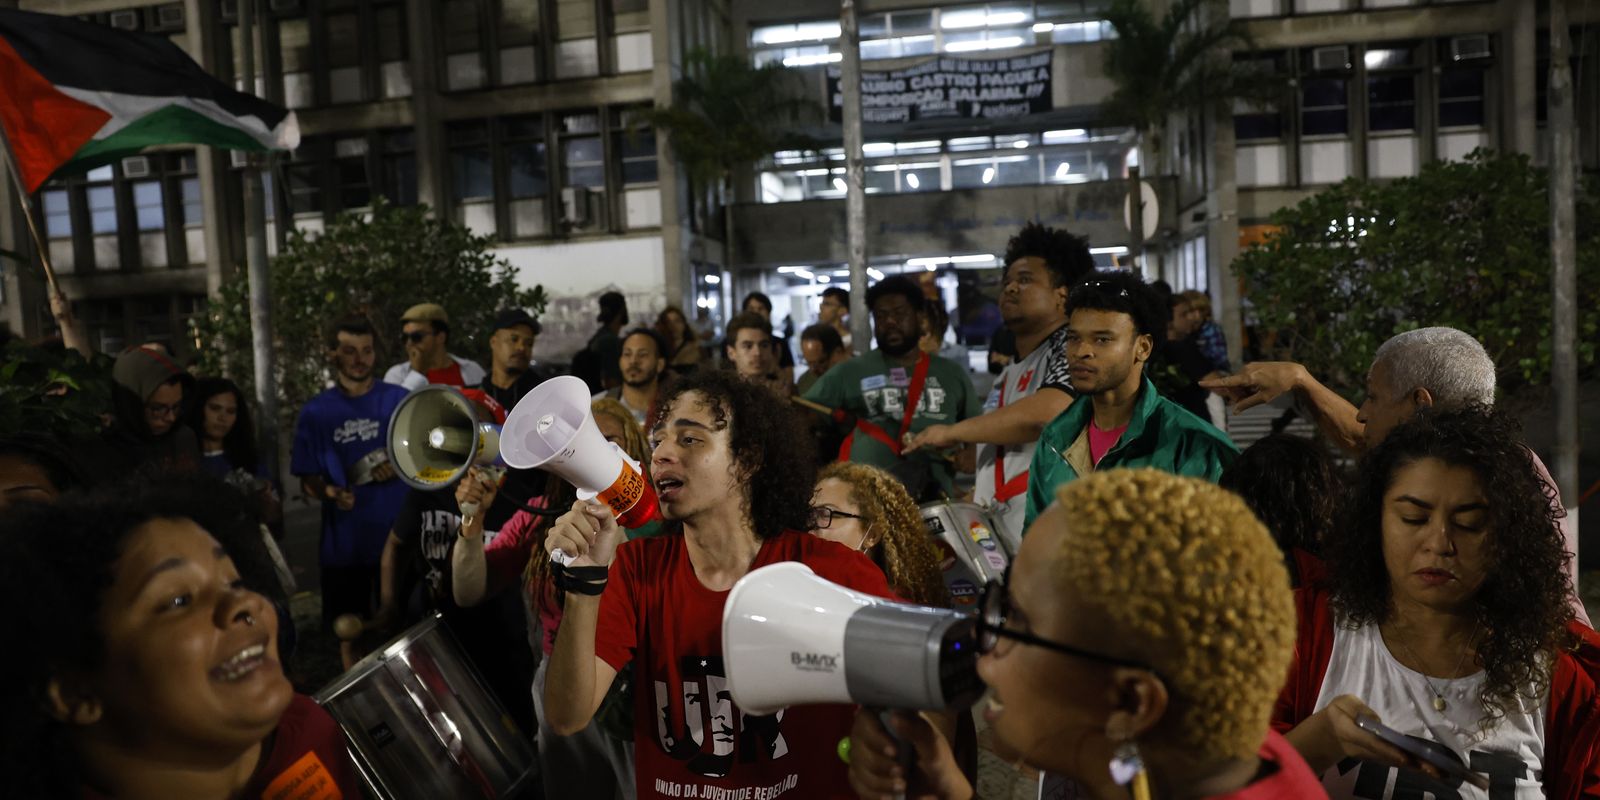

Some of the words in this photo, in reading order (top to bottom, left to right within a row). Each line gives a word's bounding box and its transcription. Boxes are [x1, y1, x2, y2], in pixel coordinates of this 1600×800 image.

[910, 72, 978, 90] CASTRO
[948, 85, 1025, 101] SALARIAL
[655, 777, 681, 797] UNIÃO
[684, 784, 698, 798] DA
[700, 784, 752, 800] JUVENTUDE
[754, 773, 798, 800] REBELIÃO
